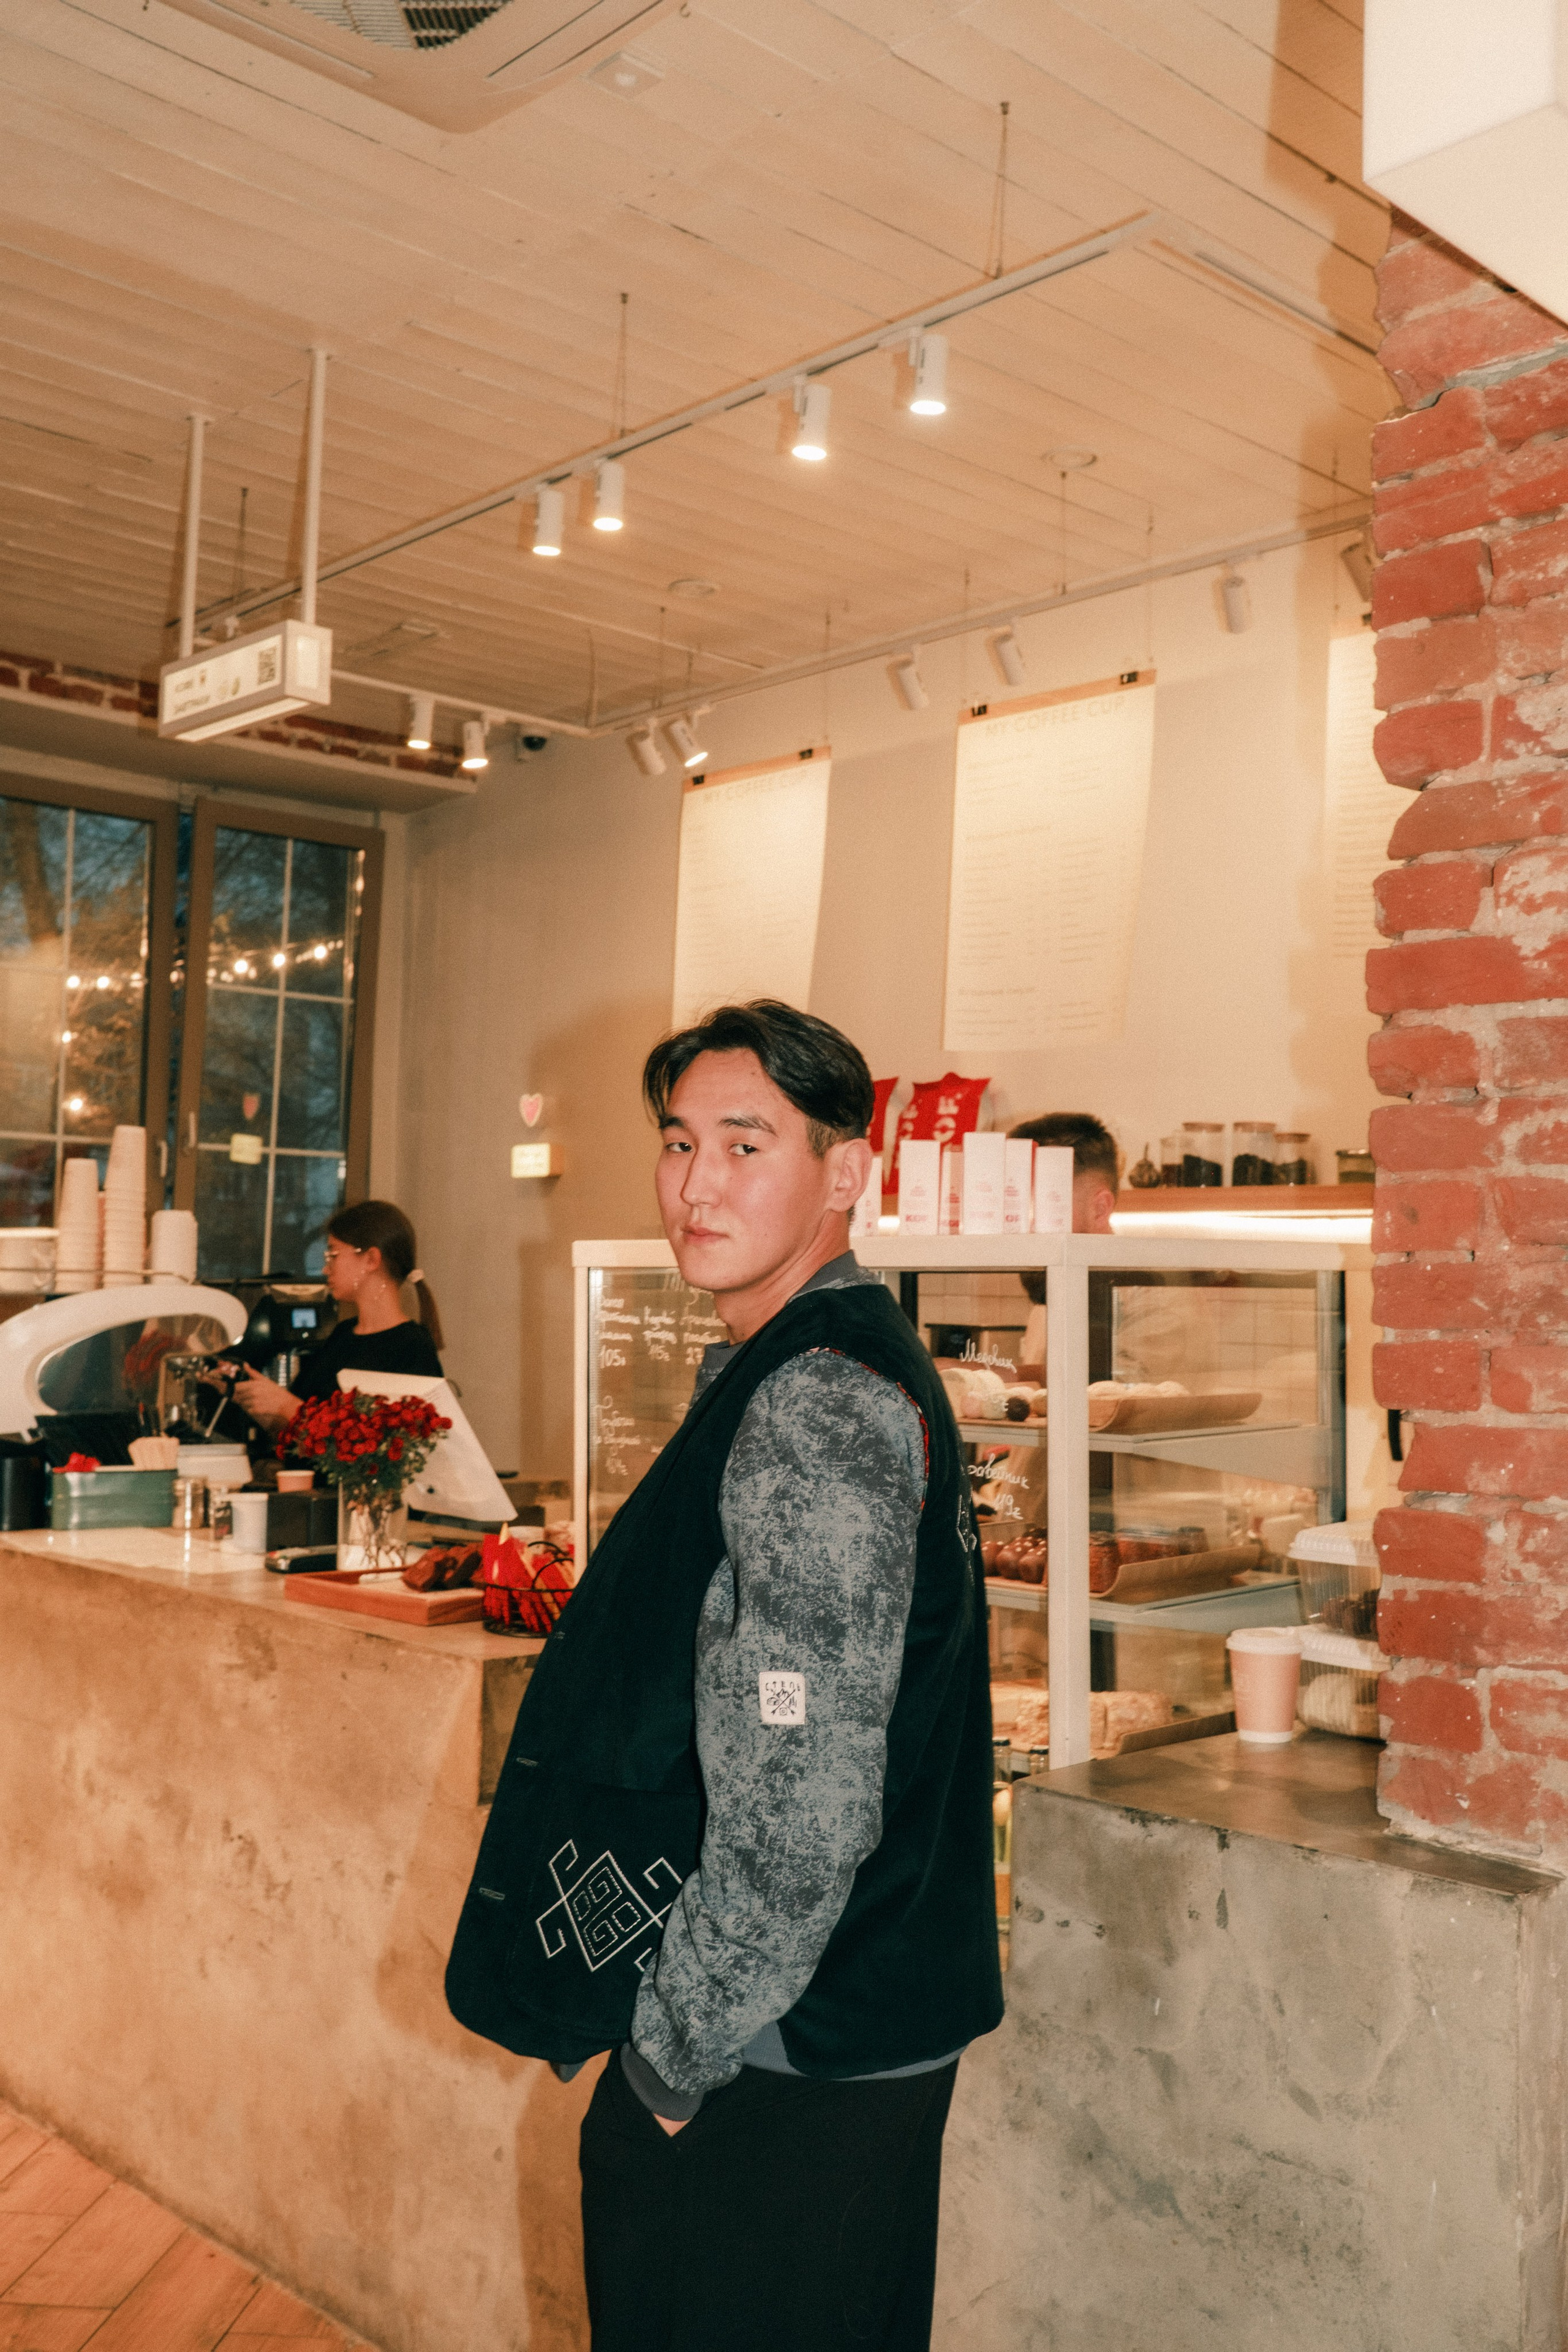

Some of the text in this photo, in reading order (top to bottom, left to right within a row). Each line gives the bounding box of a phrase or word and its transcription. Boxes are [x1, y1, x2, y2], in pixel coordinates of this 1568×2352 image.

[986, 695, 1126, 737] MY COFFEE CUP
[959, 1338, 1017, 1374] Медовик
